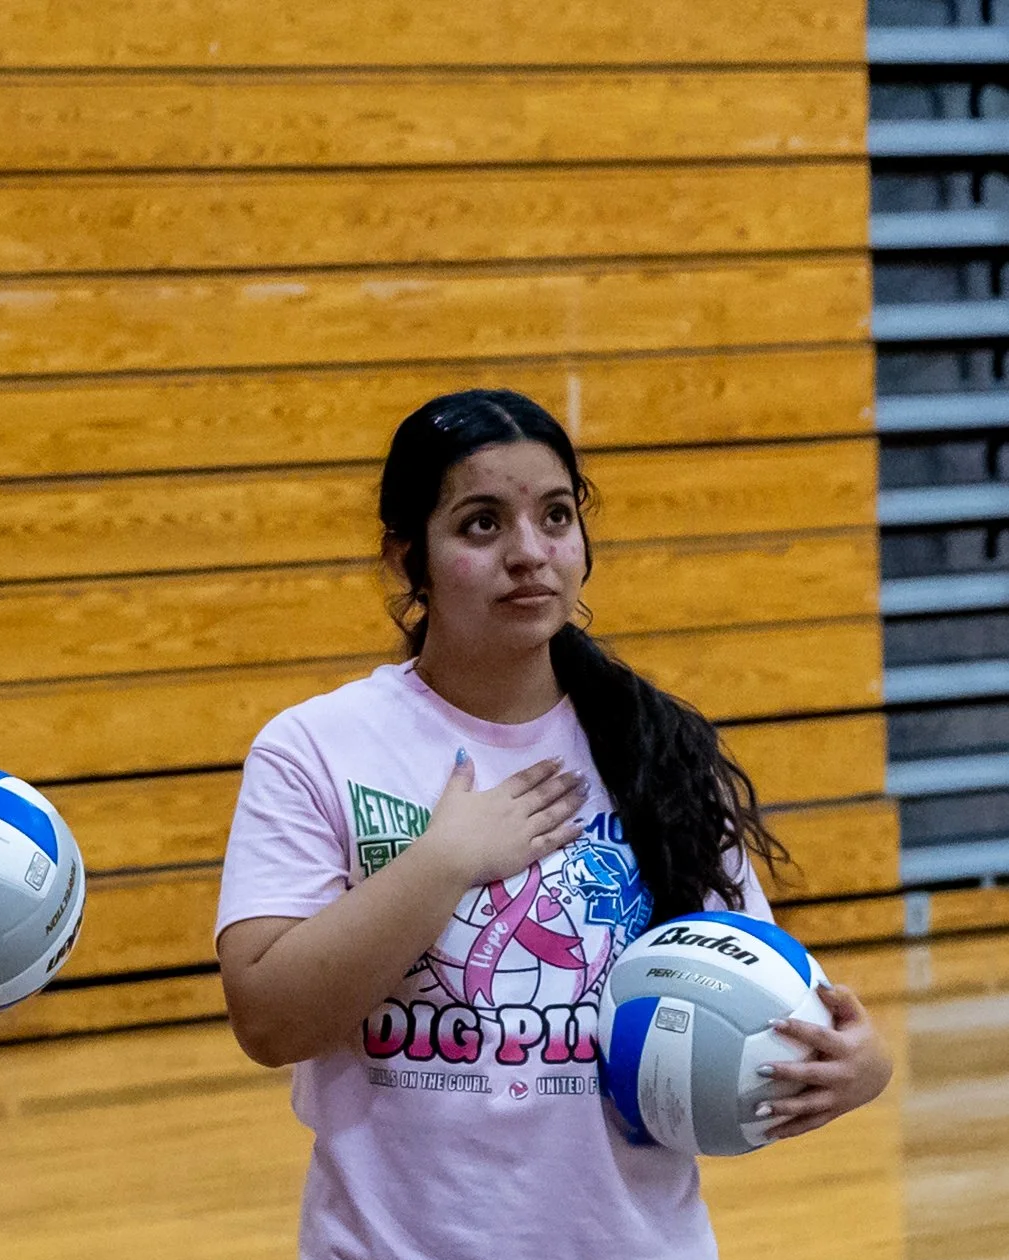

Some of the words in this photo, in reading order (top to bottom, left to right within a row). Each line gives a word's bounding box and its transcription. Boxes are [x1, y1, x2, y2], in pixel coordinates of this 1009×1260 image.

[469, 920, 508, 969] Hope
[648, 926, 760, 967] Baden
[363, 998, 484, 1064] DIG
[400, 1071, 417, 1089] ON
[421, 1072, 445, 1091] THE
[447, 1074, 492, 1094] COURT.
[536, 1076, 586, 1096] UNITED
